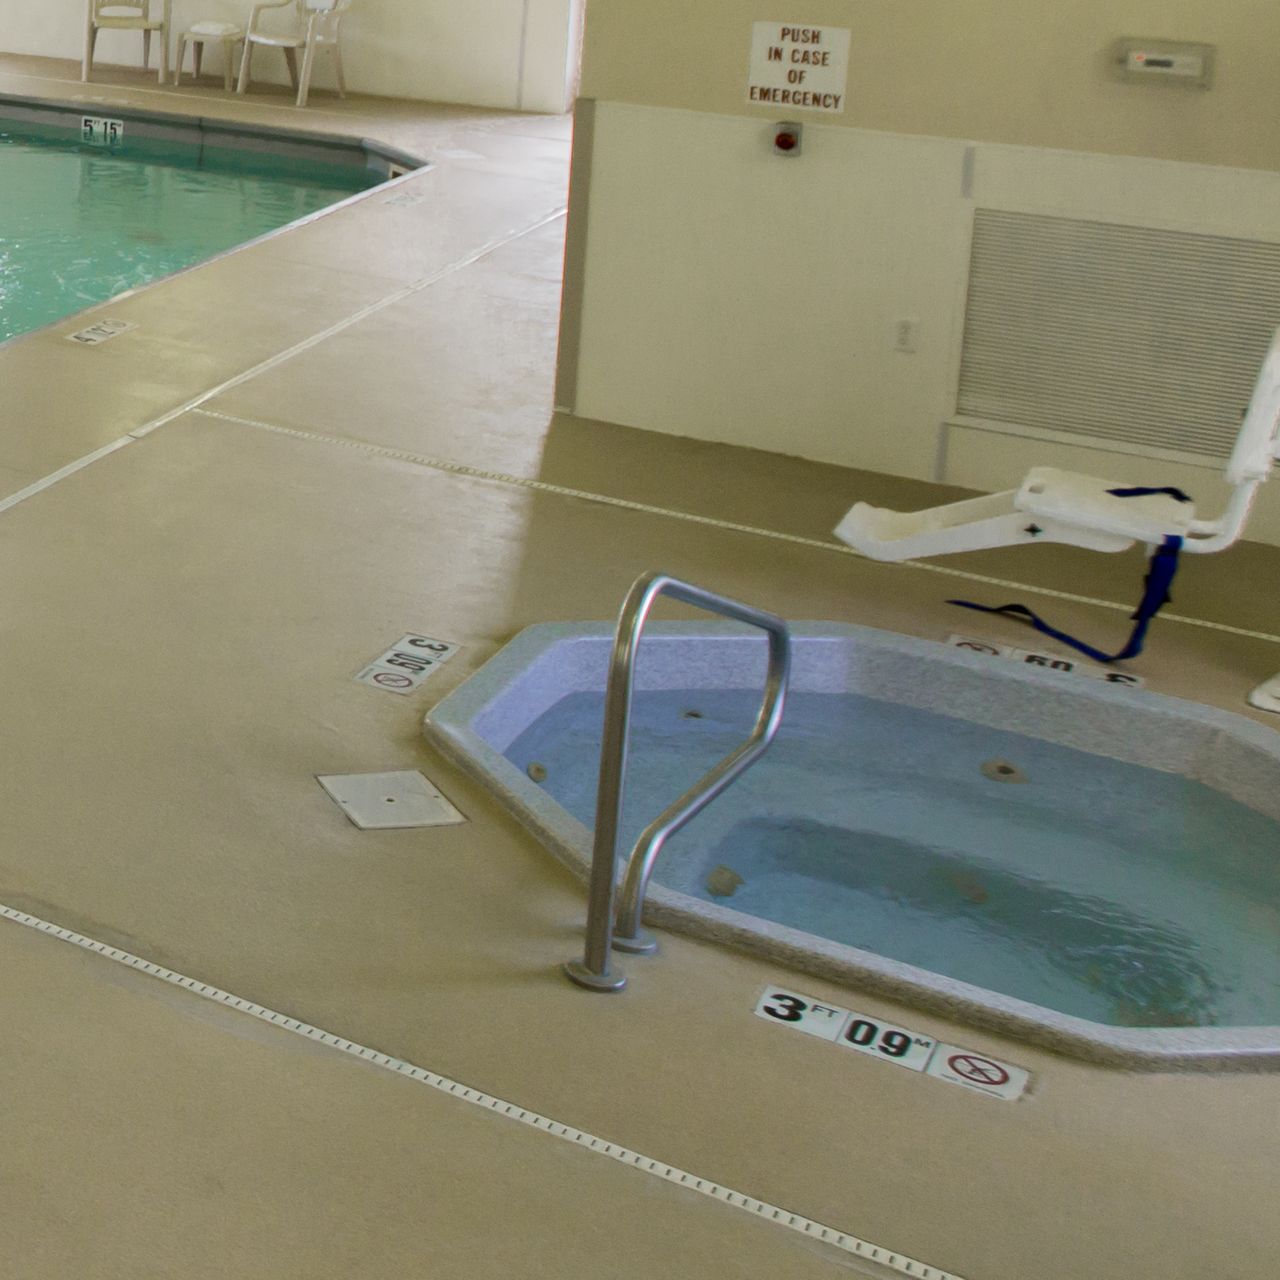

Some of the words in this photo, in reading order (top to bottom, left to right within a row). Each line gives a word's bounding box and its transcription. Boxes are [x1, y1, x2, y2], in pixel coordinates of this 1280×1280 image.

[781, 26, 821, 44] PUSH
[768, 46, 783, 61] IN
[791, 48, 830, 67] CASE
[787, 69, 807, 84] OF
[749, 85, 842, 109] EMERGENCY
[407, 638, 449, 652] 3
[763, 993, 808, 1022] 3
[810, 1004, 839, 1019] FT
[913, 1037, 931, 1049] M
